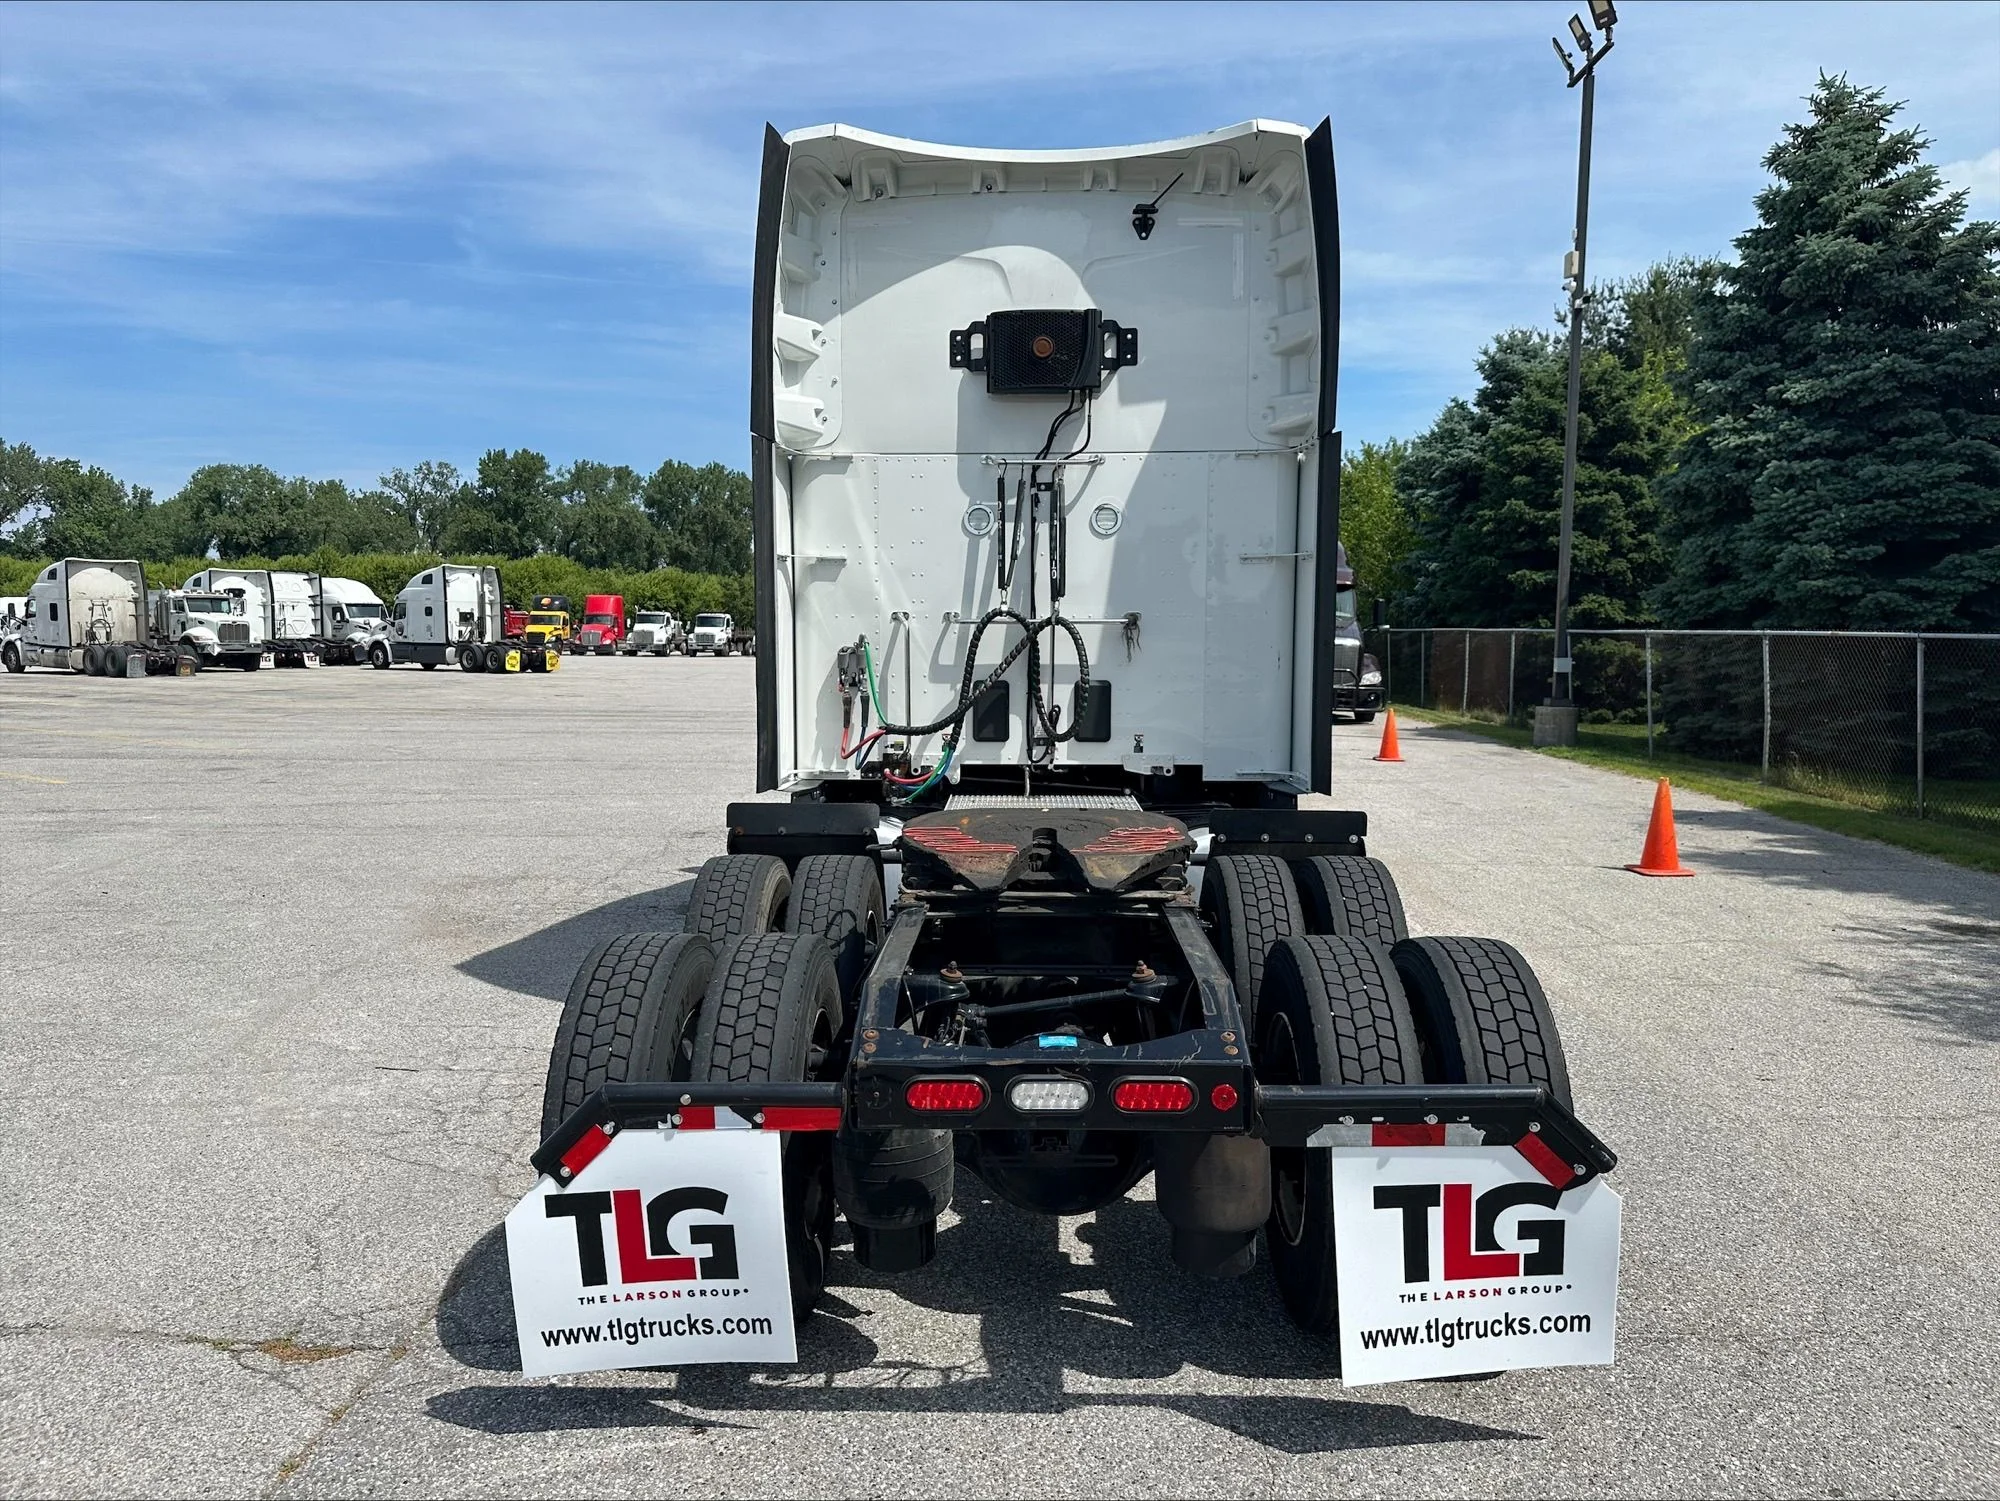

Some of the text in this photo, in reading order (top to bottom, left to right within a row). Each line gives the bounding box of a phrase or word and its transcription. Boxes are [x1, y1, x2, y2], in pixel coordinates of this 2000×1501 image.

[544, 1186, 739, 1287] TLG
[1372, 1182, 1566, 1284] TLG
[578, 1295, 608, 1305] THE
[612, 1290, 681, 1303] LARSON
[1399, 1292, 1428, 1304] THE
[1433, 1287, 1502, 1301] LARSON
[541, 1313, 773, 1347] www.tlgtrucks.com
[1361, 1311, 1592, 1349] www.tlgtrucks.com
